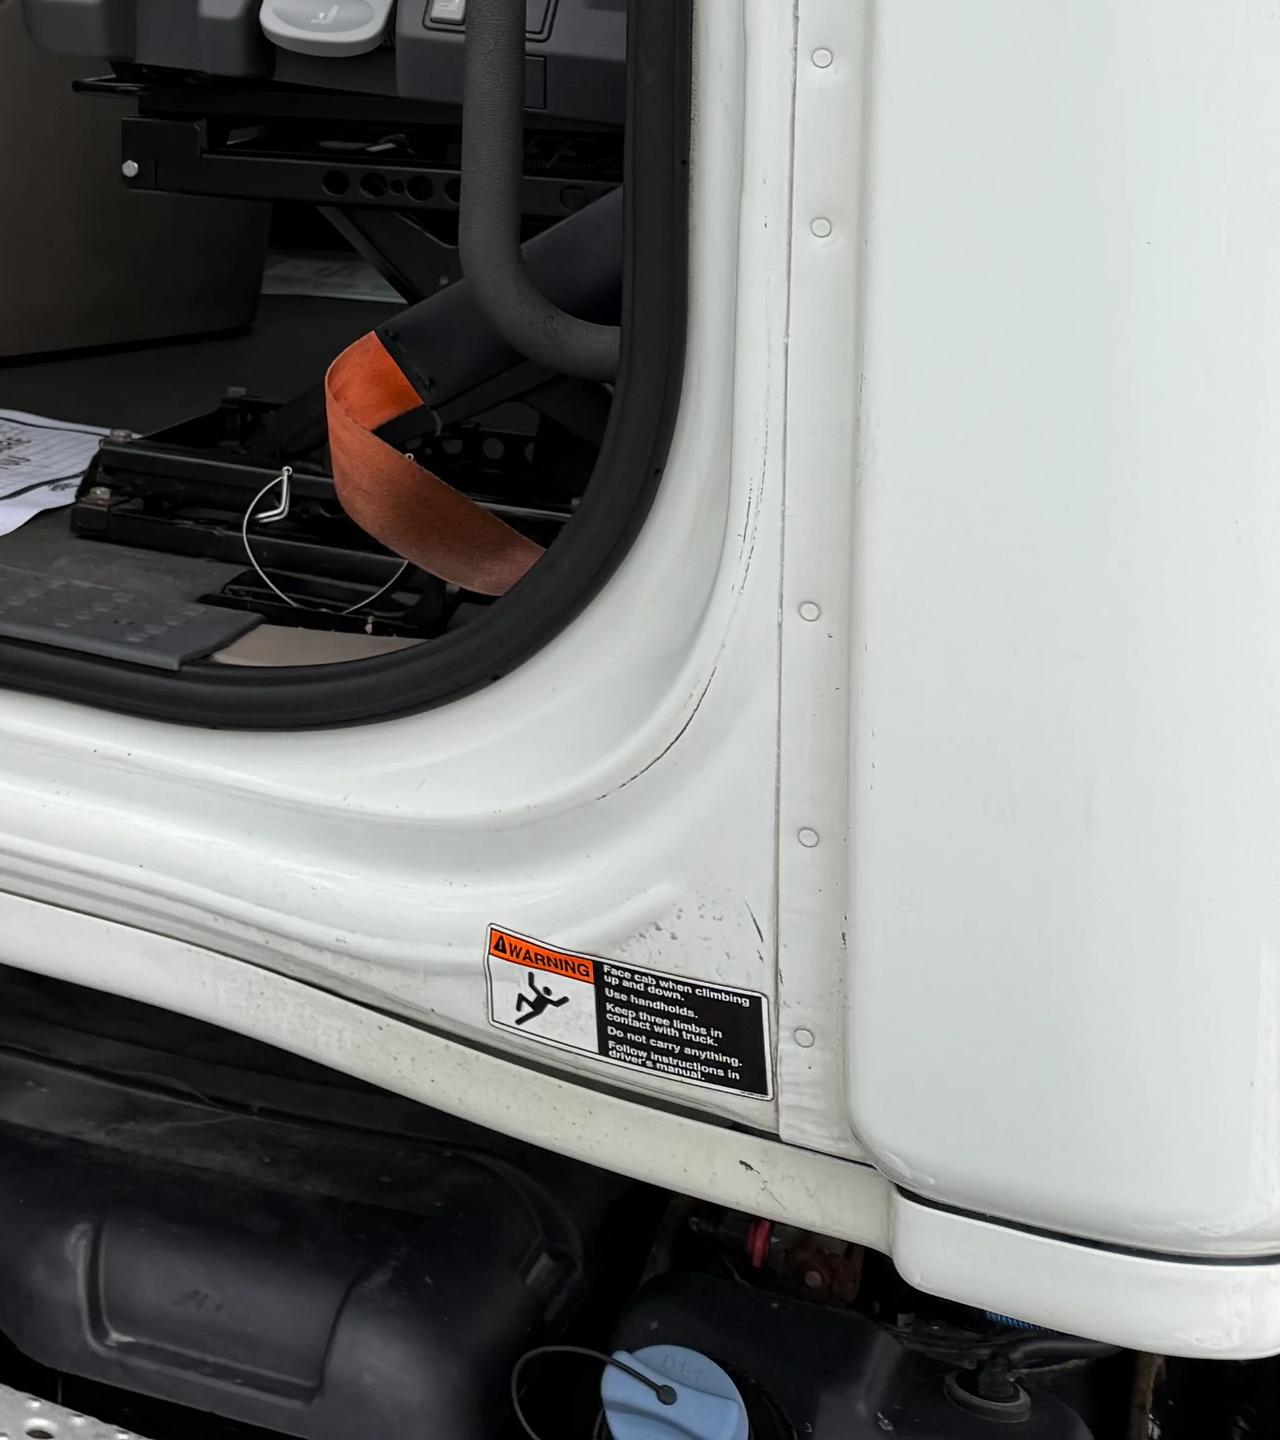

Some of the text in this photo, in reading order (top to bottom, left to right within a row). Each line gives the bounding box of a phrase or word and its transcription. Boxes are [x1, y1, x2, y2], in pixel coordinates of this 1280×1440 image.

[508, 944, 590, 978] WARNING
[603, 964, 750, 1008] Face cab when climbing
[604, 976, 685, 1001] up and down.
[604, 988, 699, 1019] Use handholds.
[606, 1002, 723, 1038] Keep three limbs in
[606, 1013, 718, 1047] contact with truck.
[608, 1026, 742, 1067] Do not carry anything.
[608, 1041, 740, 1080] Follow instructions in
[608, 1050, 706, 1080] driver's manual.
